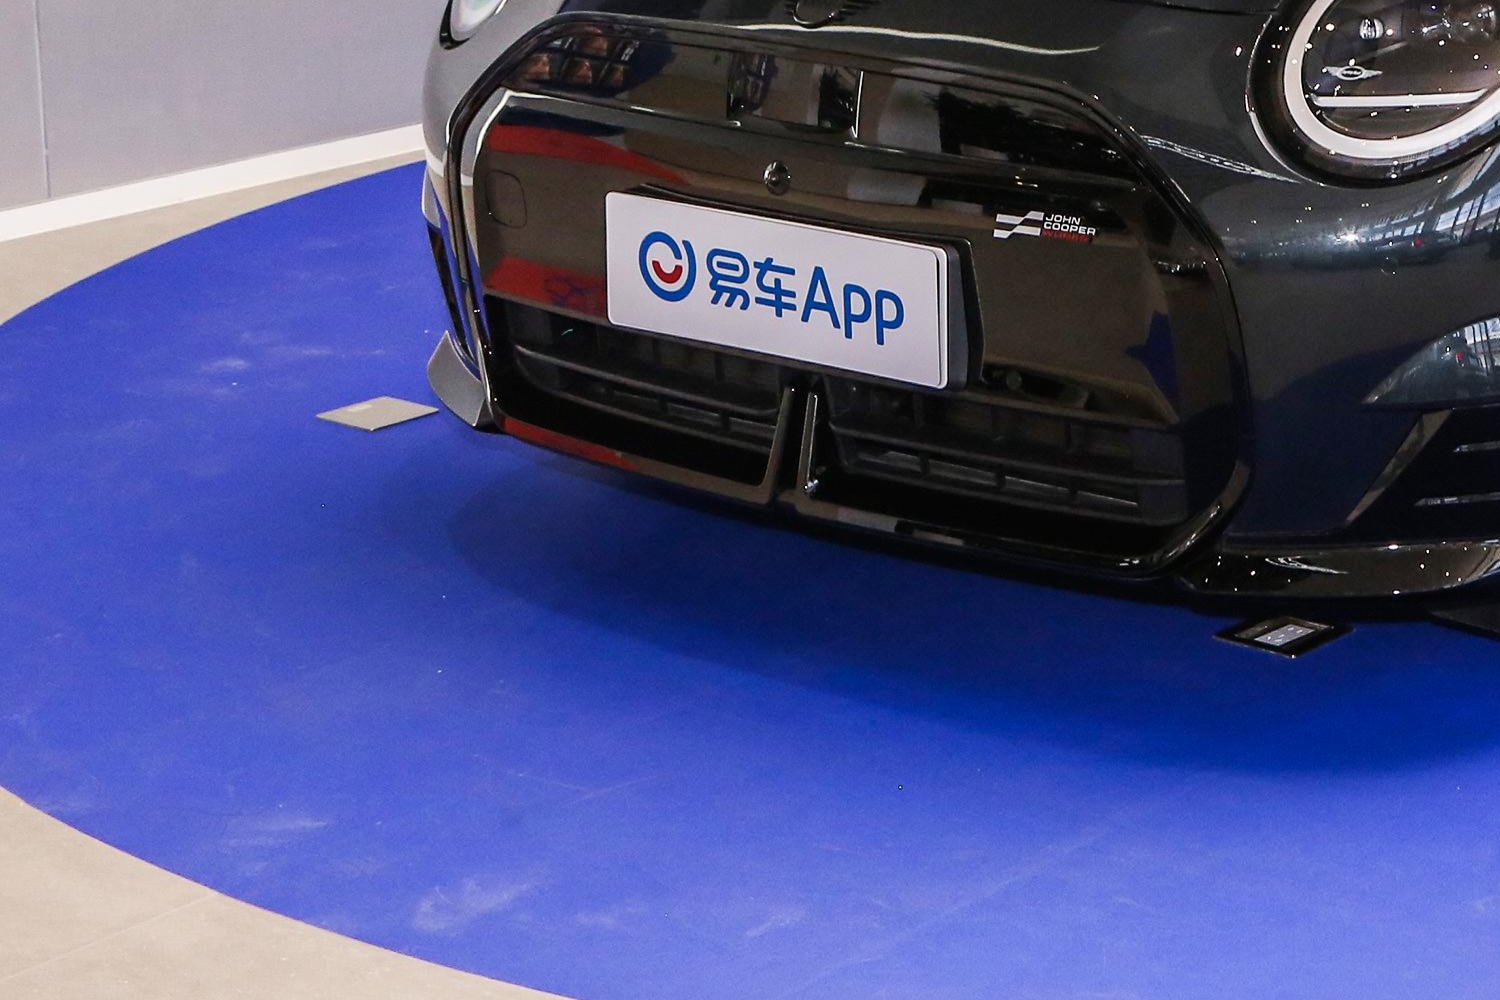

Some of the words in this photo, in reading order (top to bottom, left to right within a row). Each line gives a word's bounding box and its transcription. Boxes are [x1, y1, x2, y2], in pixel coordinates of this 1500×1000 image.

[1045, 213, 1082, 226] JOHN
[1043, 221, 1097, 237] COOPER
[706, 247, 905, 346] 易车App
